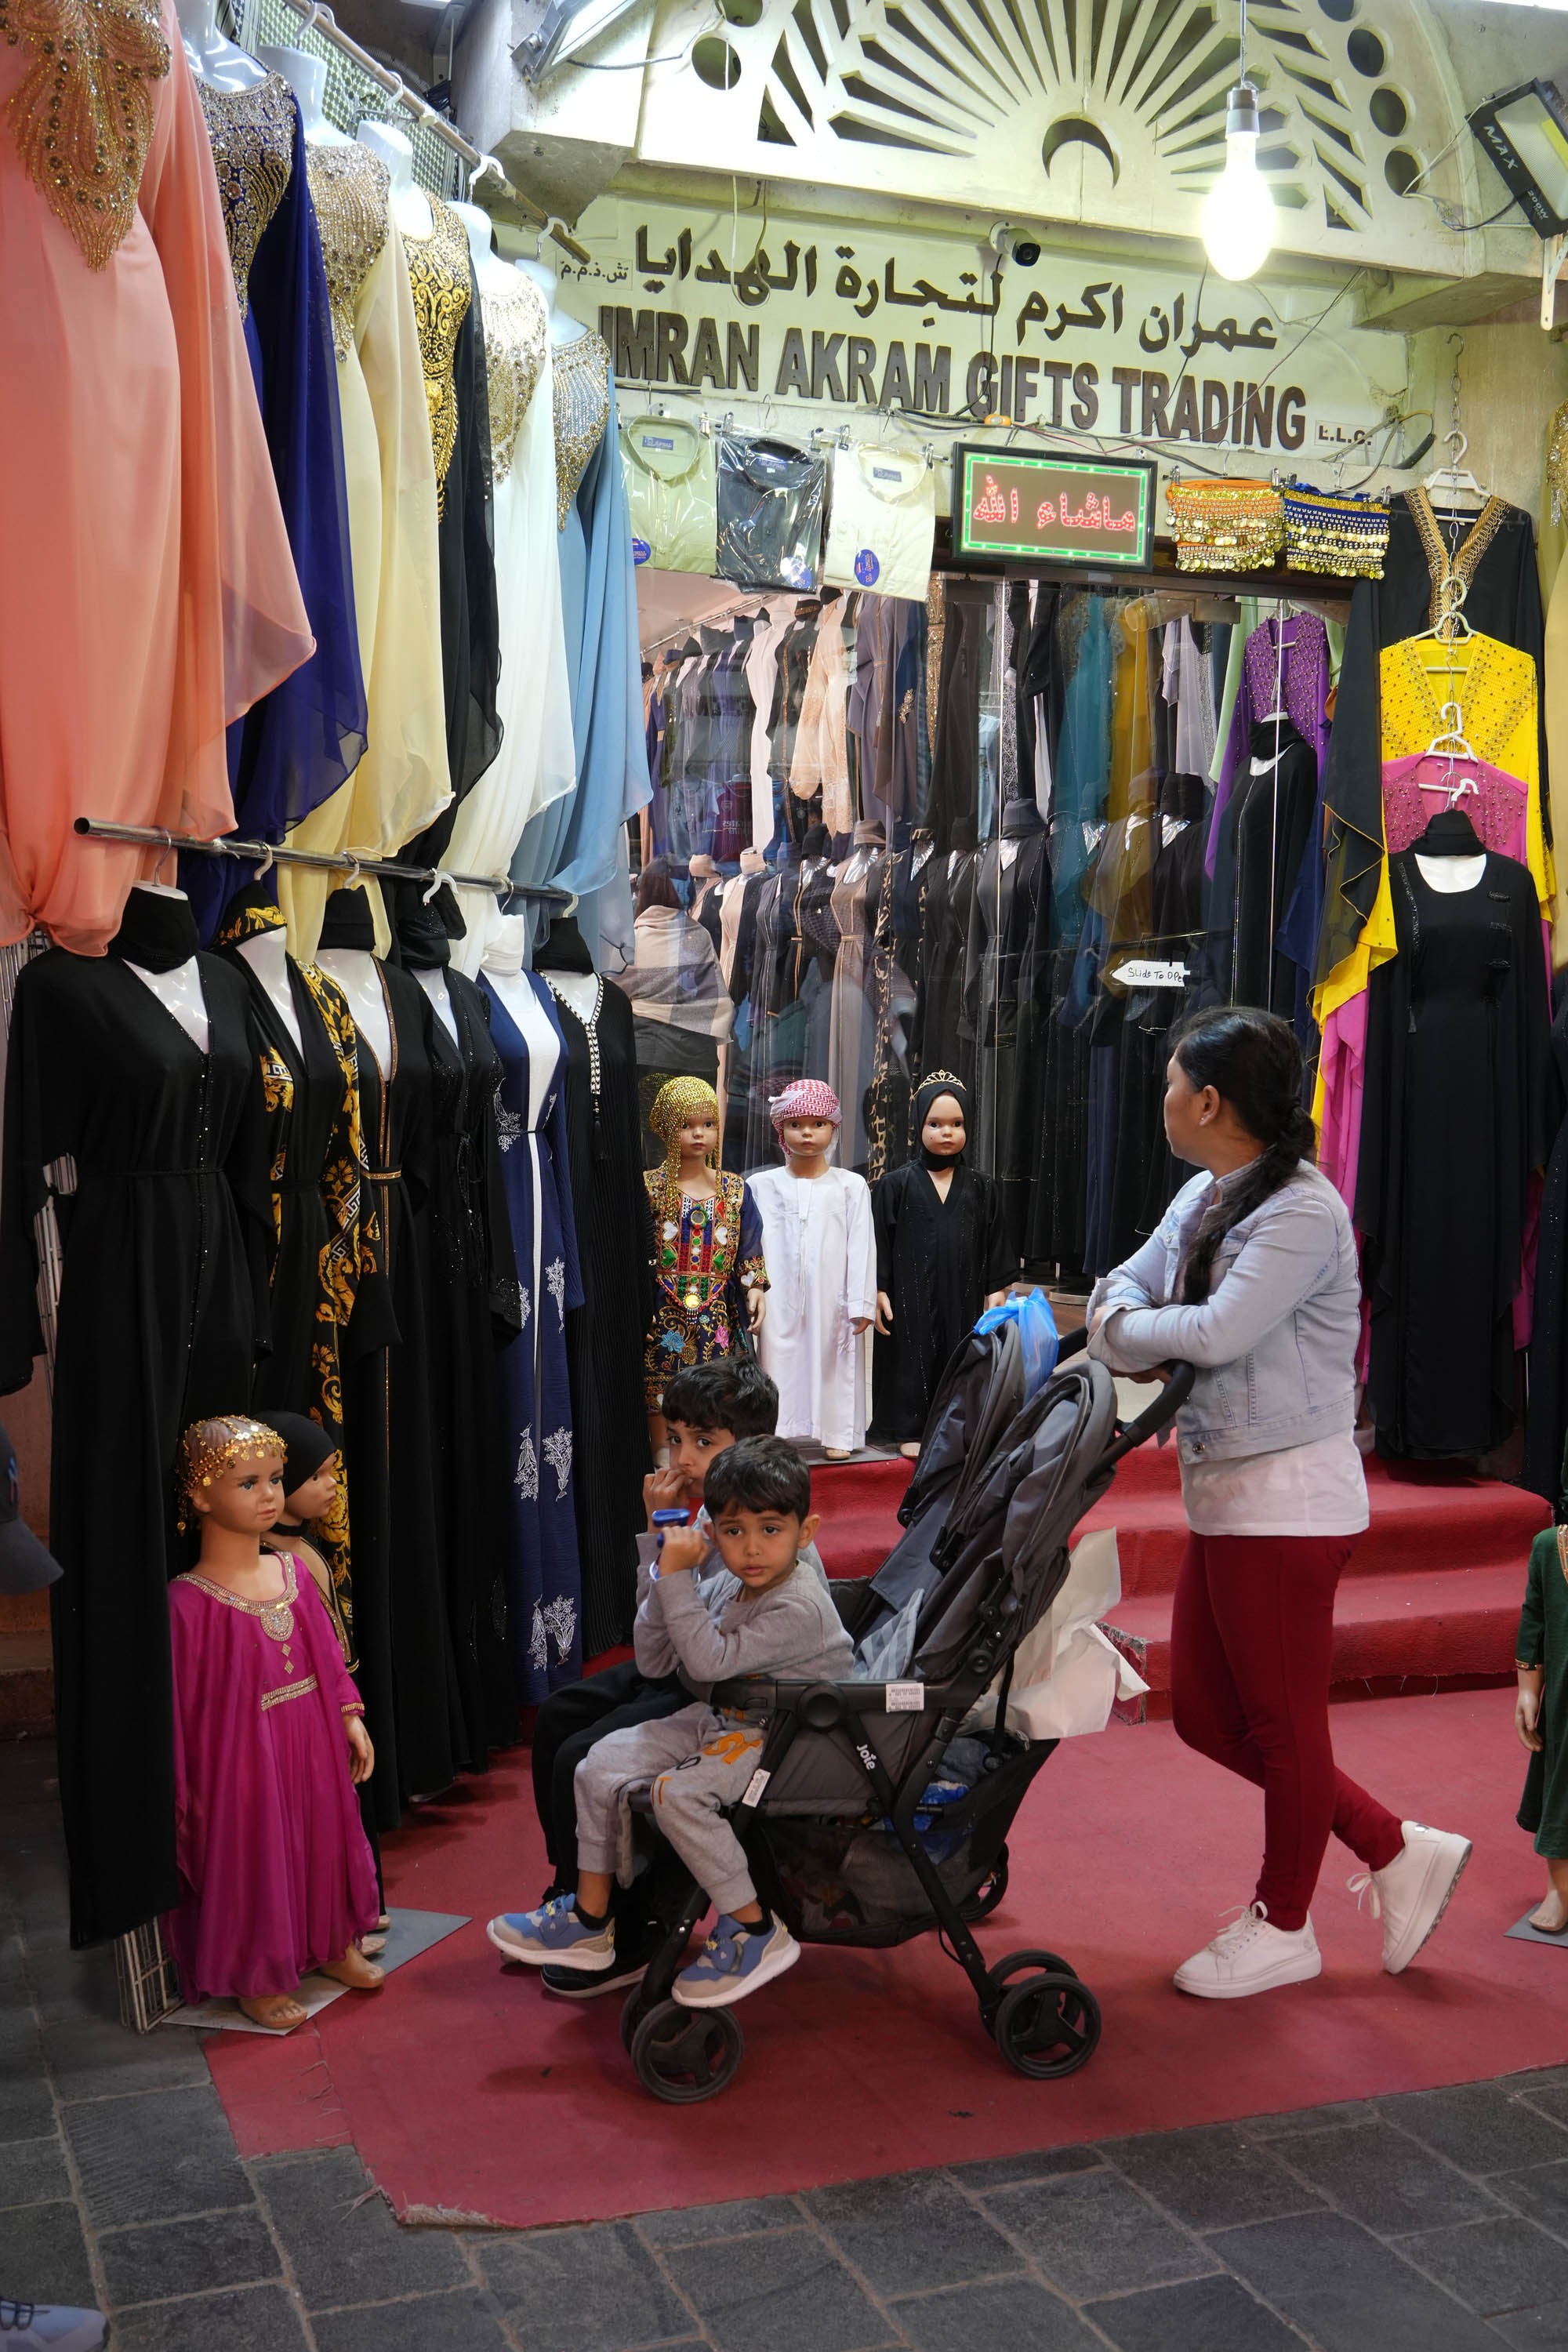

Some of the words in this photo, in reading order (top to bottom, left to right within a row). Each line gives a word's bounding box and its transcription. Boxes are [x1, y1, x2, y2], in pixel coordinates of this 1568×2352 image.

[1483, 125, 1518, 169] MAX
[1527, 190, 1549, 220] 200W
[636, 224, 817, 306] الهدايا
[1016, 281, 1124, 346] اكرم
[1139, 292, 1277, 358] عمران
[775, 327, 952, 414] AKRAM
[966, 351, 1098, 430] GIFTS
[1112, 366, 1306, 451] TRADING
[1319, 425, 1371, 445] L.L.C.
[973, 474, 1018, 524] الله
[1036, 492, 1135, 532] ماشاء
